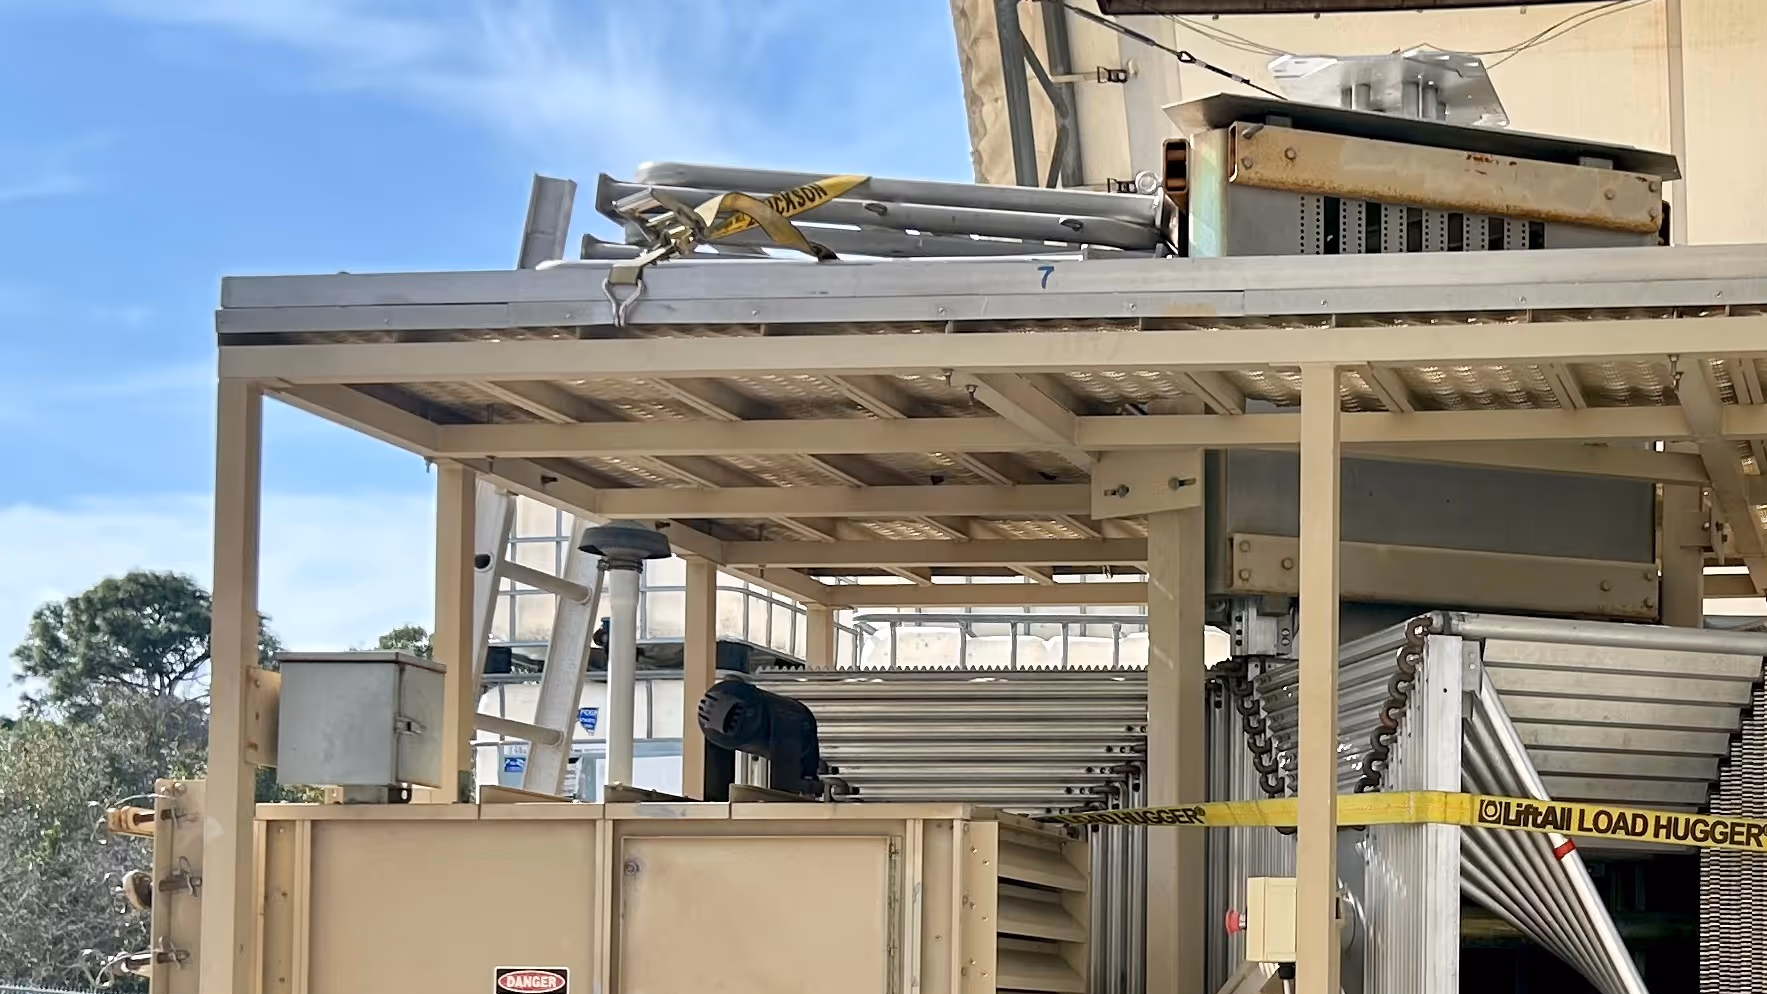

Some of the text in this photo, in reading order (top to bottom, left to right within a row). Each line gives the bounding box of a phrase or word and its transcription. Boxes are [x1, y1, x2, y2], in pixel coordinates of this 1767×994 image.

[1037, 265, 1055, 289] 7
[1577, 808, 1649, 836] LOAD
[506, 975, 557, 987] DANGER
